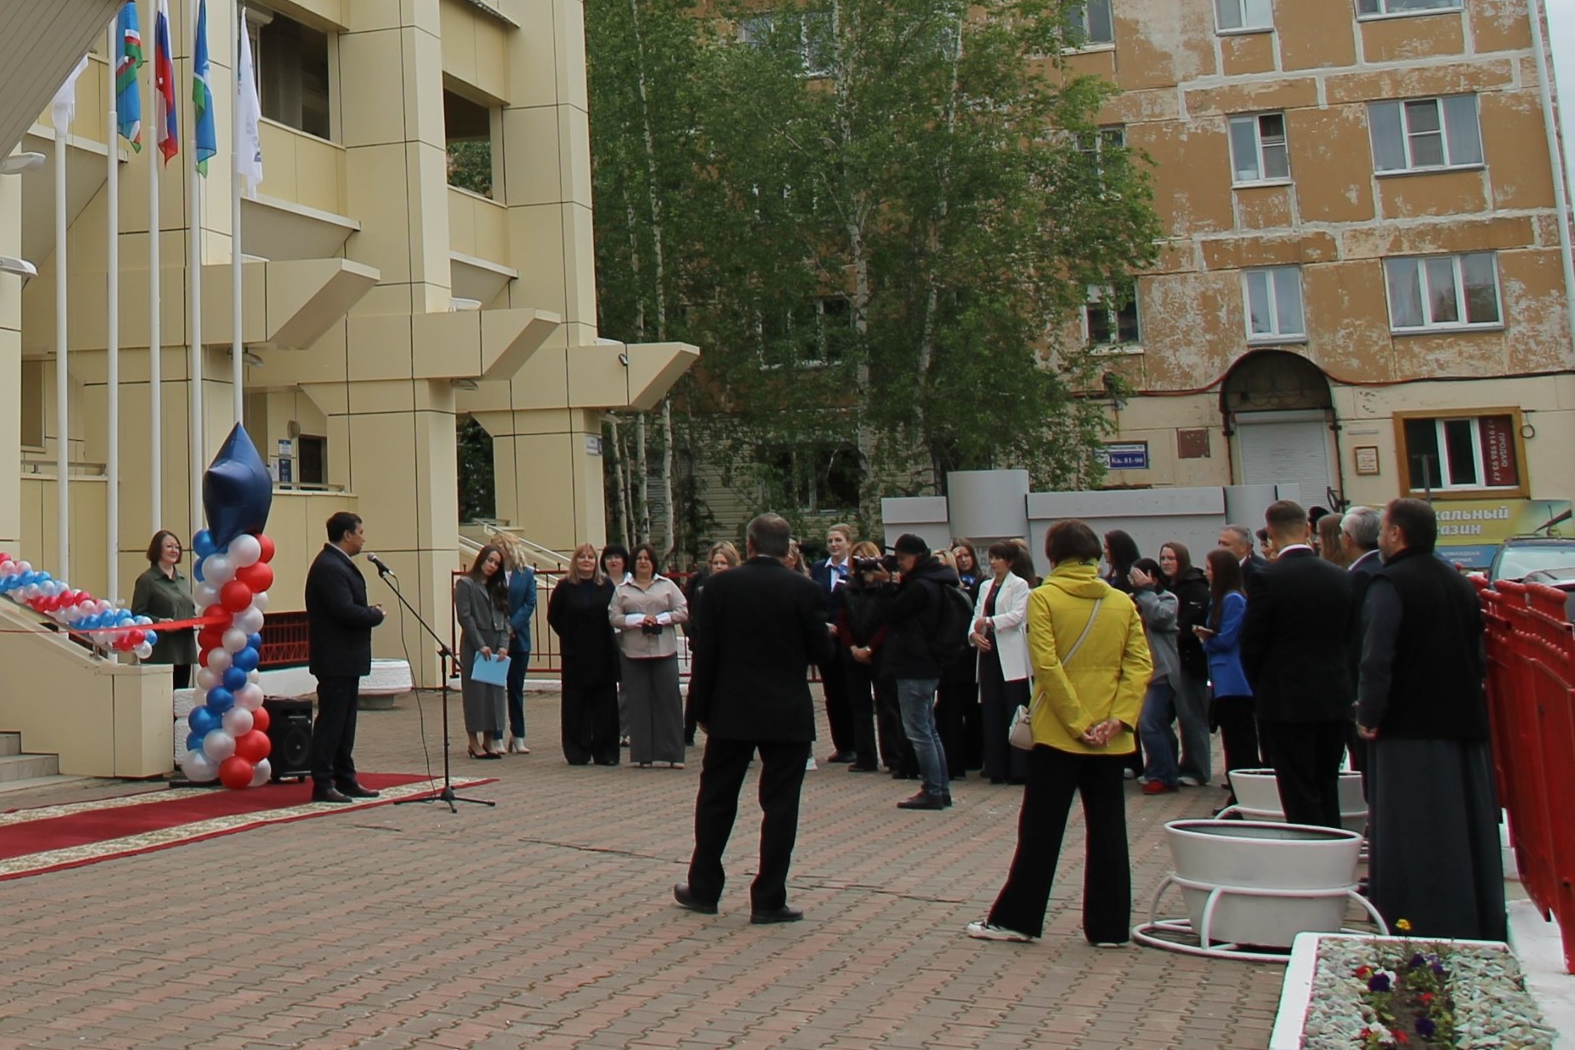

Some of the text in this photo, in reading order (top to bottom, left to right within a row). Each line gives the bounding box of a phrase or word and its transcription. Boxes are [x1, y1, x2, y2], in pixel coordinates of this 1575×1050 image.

[1489, 430, 1497, 445] 914
[1498, 432, 1508, 467] ПРОДАЮ
[1436, 506, 1509, 520] кальный
[1437, 524, 1482, 535] азин
